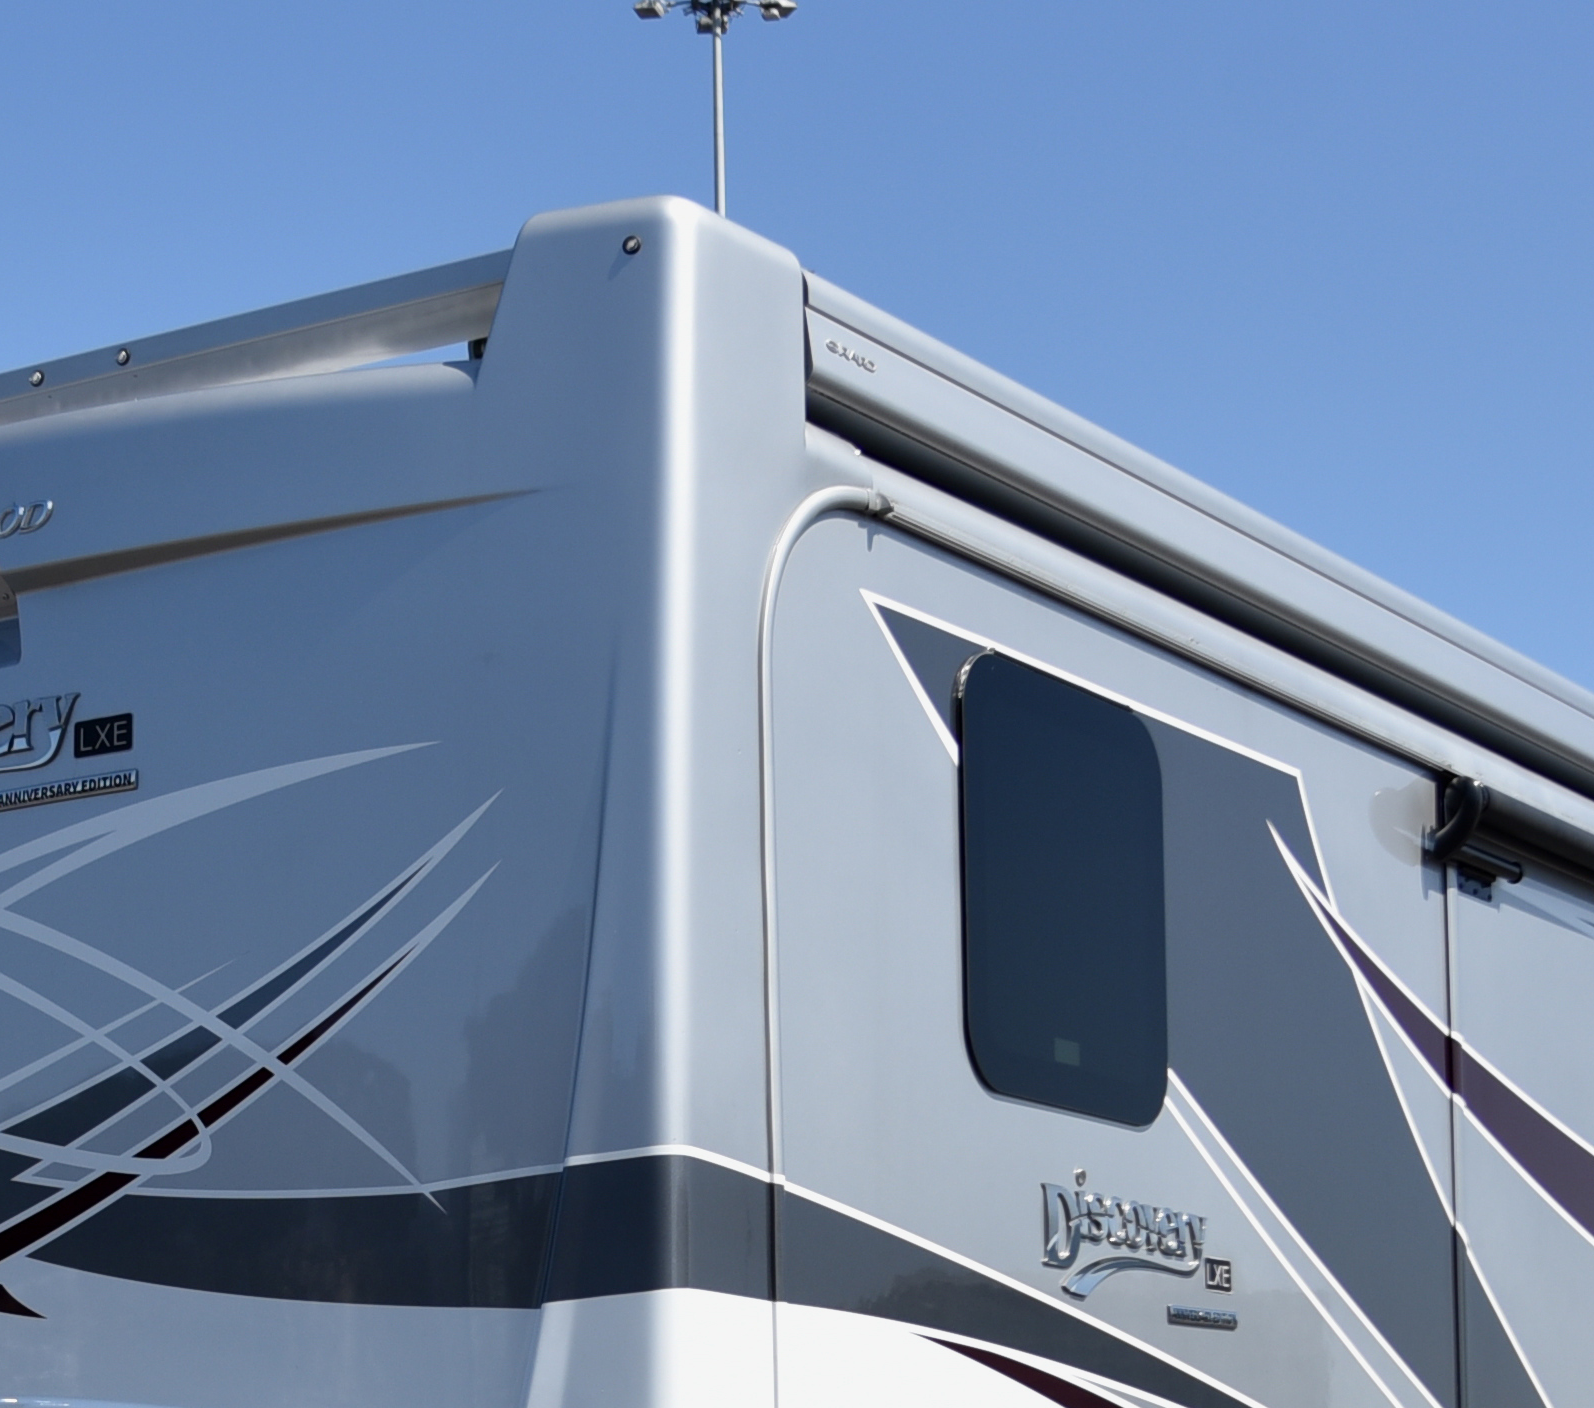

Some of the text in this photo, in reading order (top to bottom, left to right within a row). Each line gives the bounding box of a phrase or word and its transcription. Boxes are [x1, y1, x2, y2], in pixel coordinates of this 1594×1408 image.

[78, 719, 129, 753] LXE
[80, 771, 133, 793] EDITION
[1040, 1167, 1231, 1302] Discovery LXE
